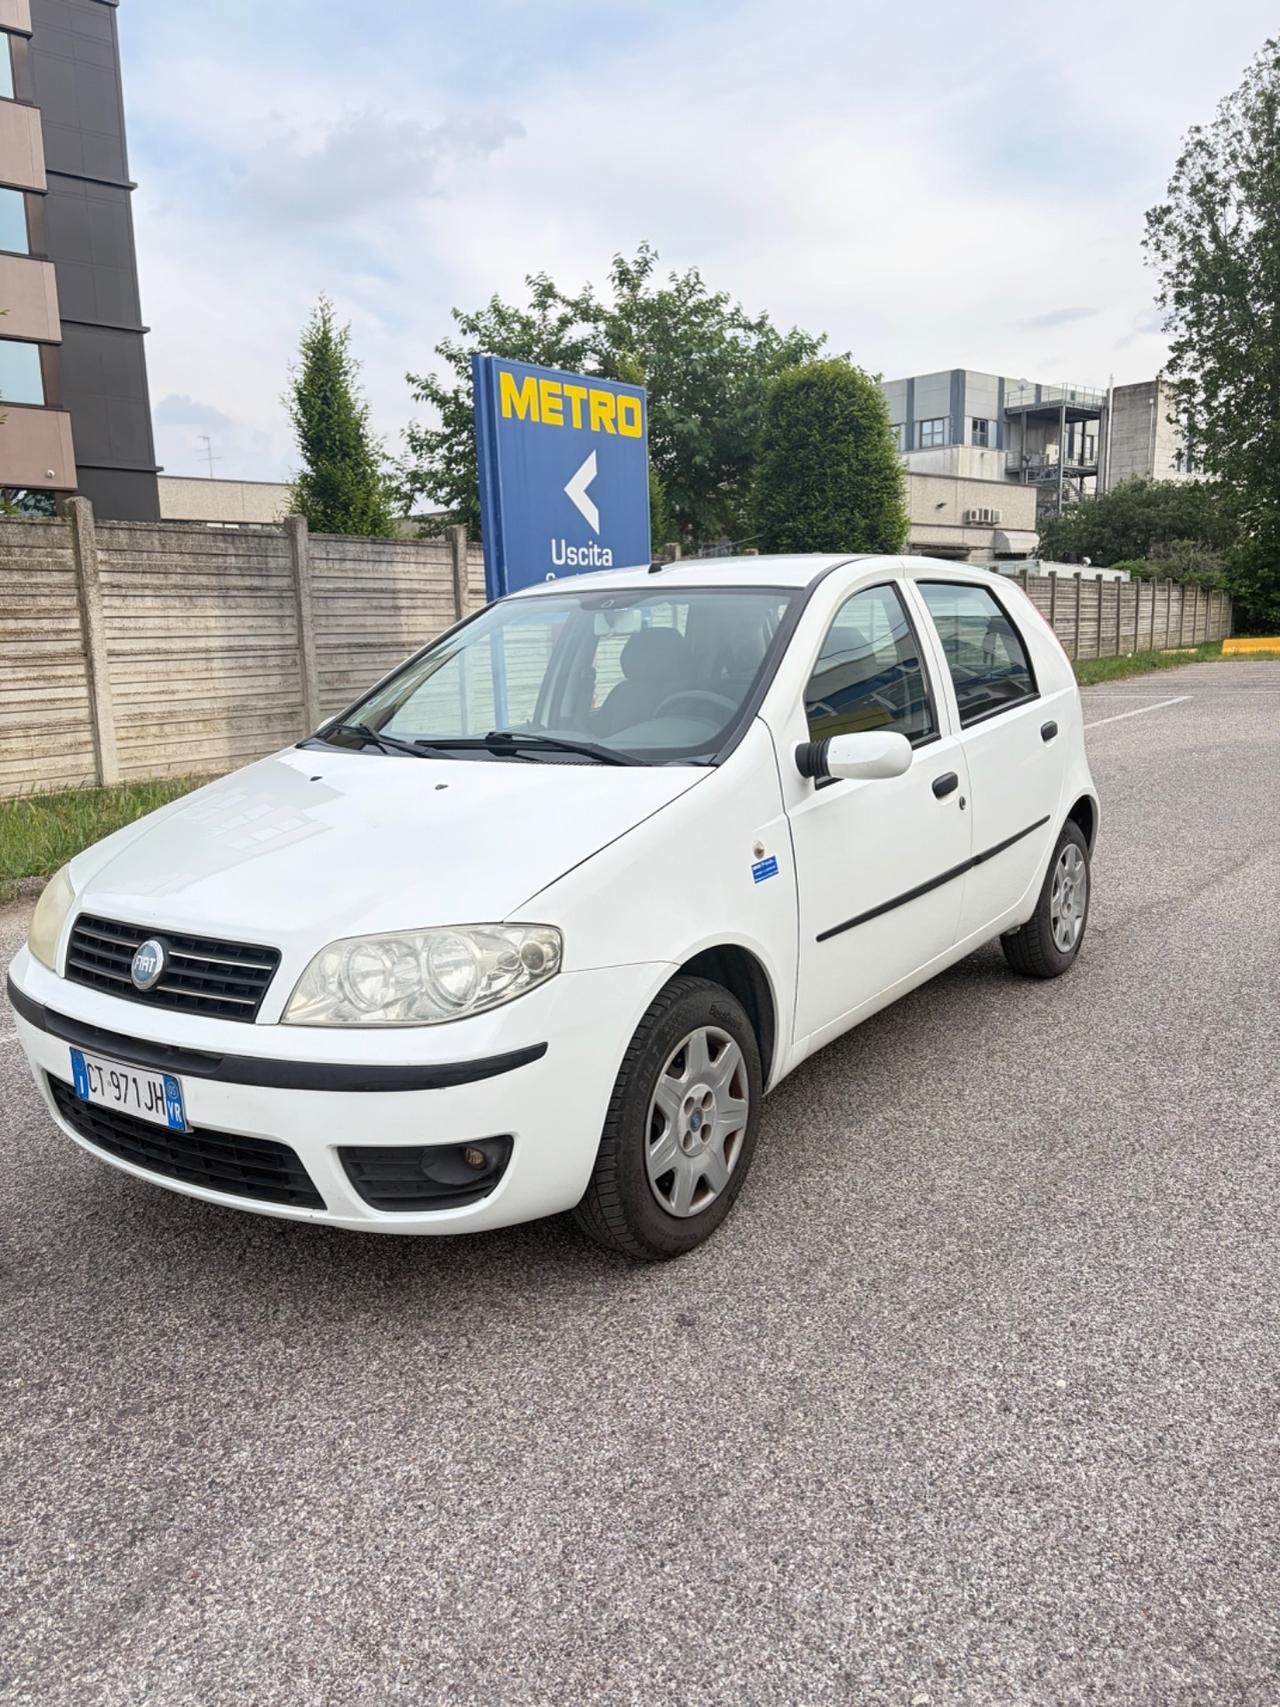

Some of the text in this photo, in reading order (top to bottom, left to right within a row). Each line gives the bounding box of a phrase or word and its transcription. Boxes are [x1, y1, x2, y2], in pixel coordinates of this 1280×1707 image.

[500, 372, 642, 438] METRO
[551, 538, 613, 566] Uscita
[133, 956, 156, 973] FIAT
[167, 1101, 182, 1122] VR
